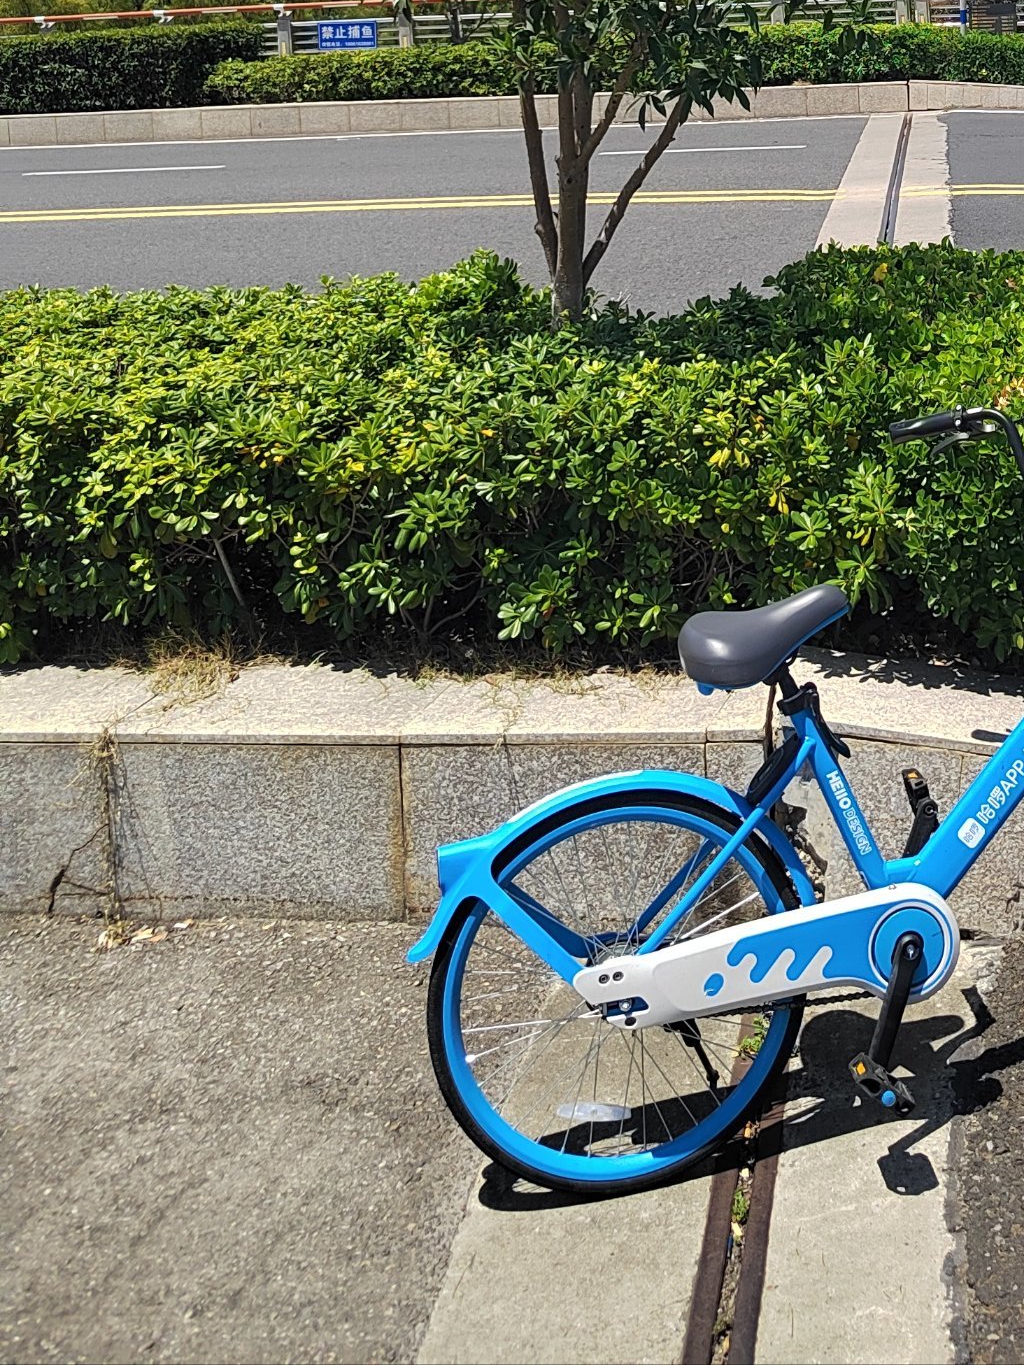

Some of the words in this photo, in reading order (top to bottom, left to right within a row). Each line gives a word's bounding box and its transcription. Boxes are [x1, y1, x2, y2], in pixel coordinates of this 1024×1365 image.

[321, 25, 374, 39] 禁止捕鱼
[843, 808, 872, 855] DESIGN
